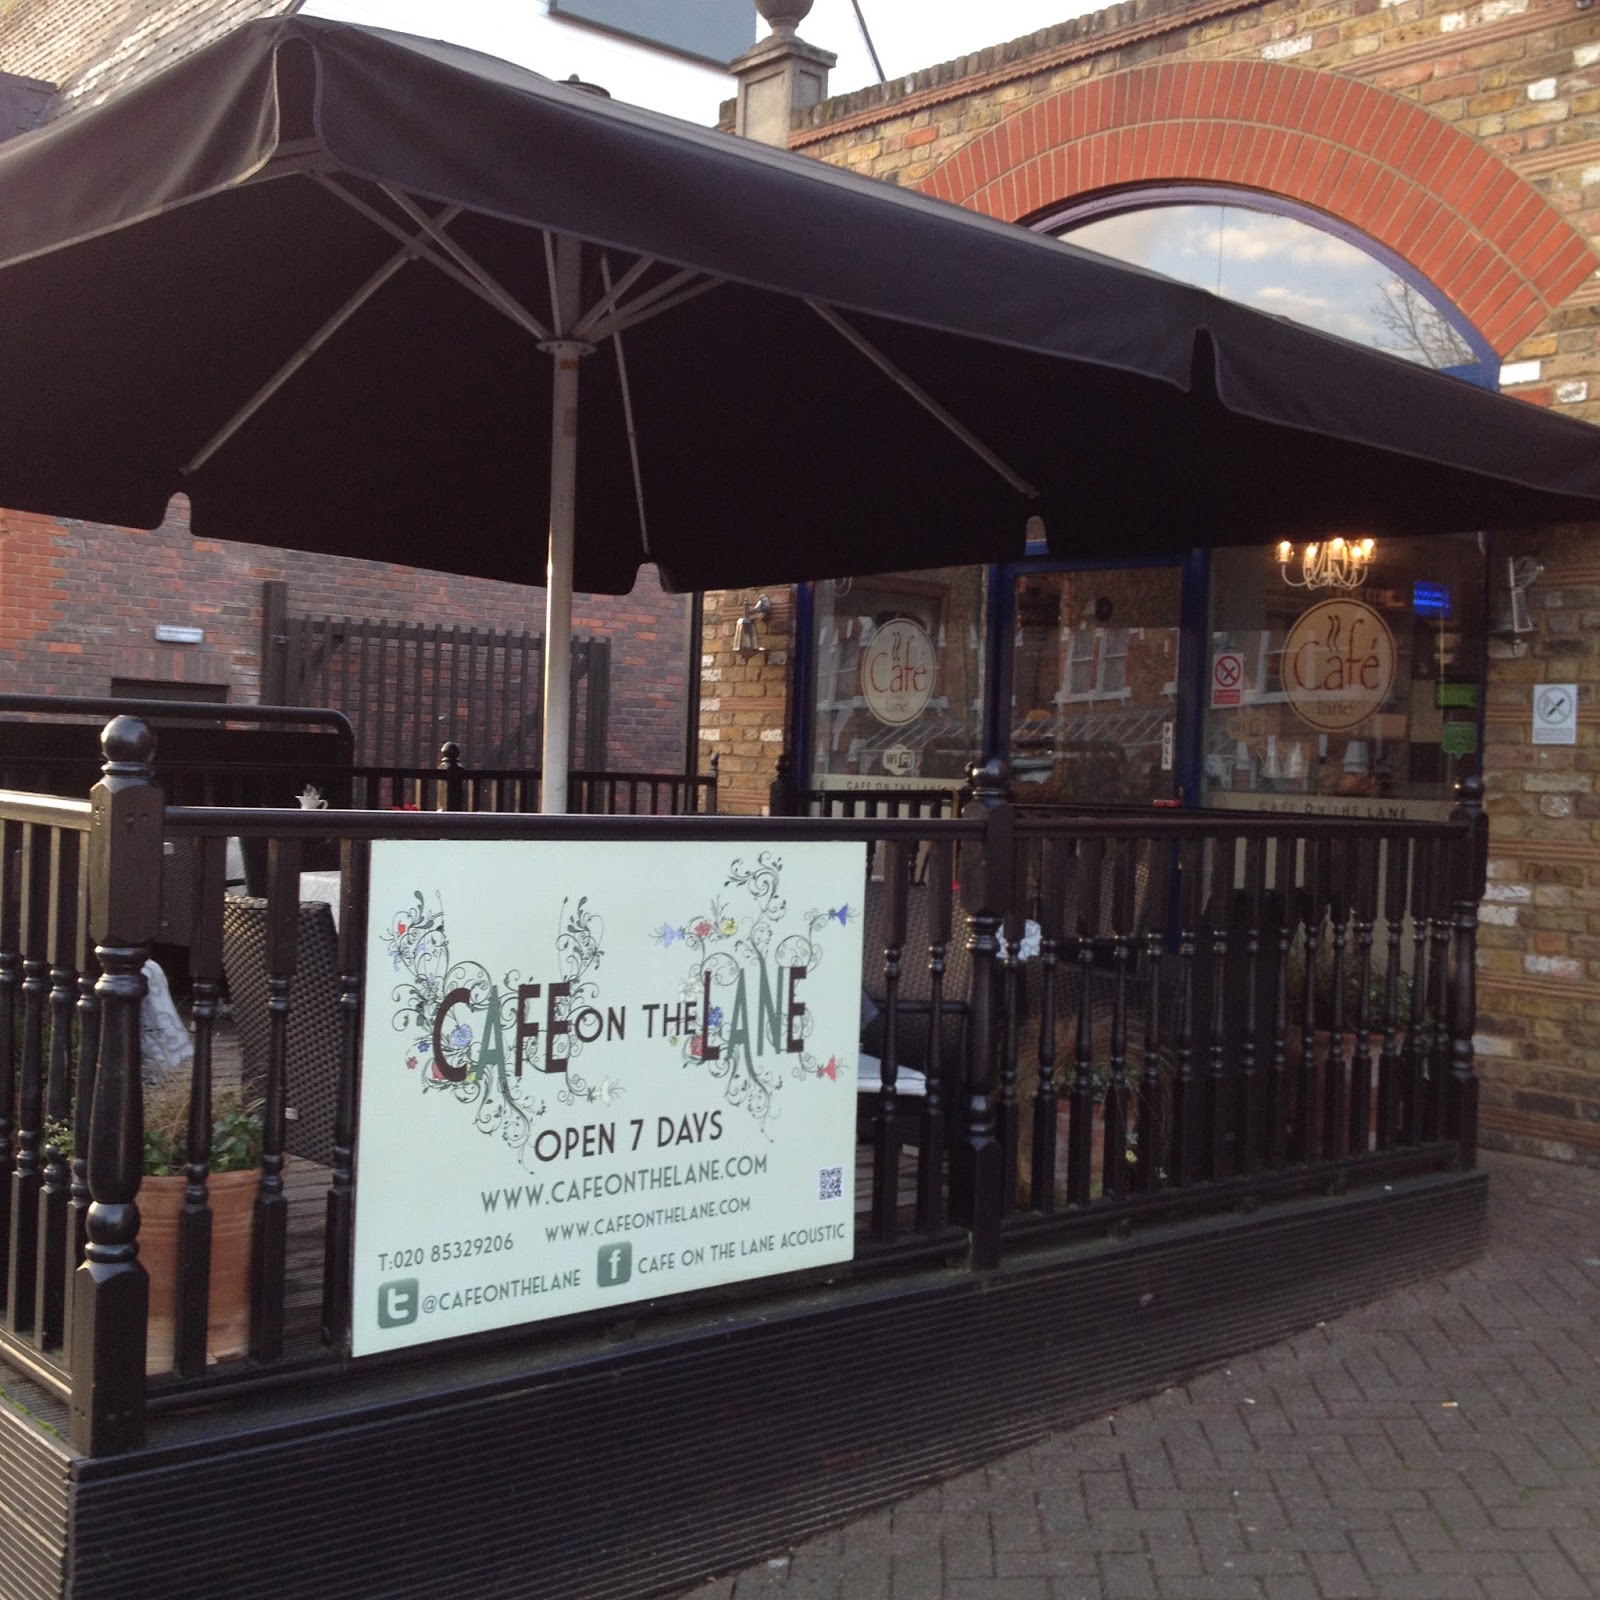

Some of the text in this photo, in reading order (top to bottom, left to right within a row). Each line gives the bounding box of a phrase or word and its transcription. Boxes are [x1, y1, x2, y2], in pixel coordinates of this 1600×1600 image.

[1368, 807, 1408, 820] LANE
[432, 964, 808, 1083] CAFE ON THE LANE
[534, 1110, 723, 1162] OPEN 7 DAYS
[481, 1154, 768, 1214] WWW.CAFEONTHELANE.COM
[545, 1197, 751, 1243] WWW.CAFEONTHELANE.COM
[431, 1233, 514, 1262] 85329206
[638, 1223, 846, 1274] CAFE ON THE LANE ACOUSTIC
[422, 1269, 581, 1314] @CAFEONTHELANE
